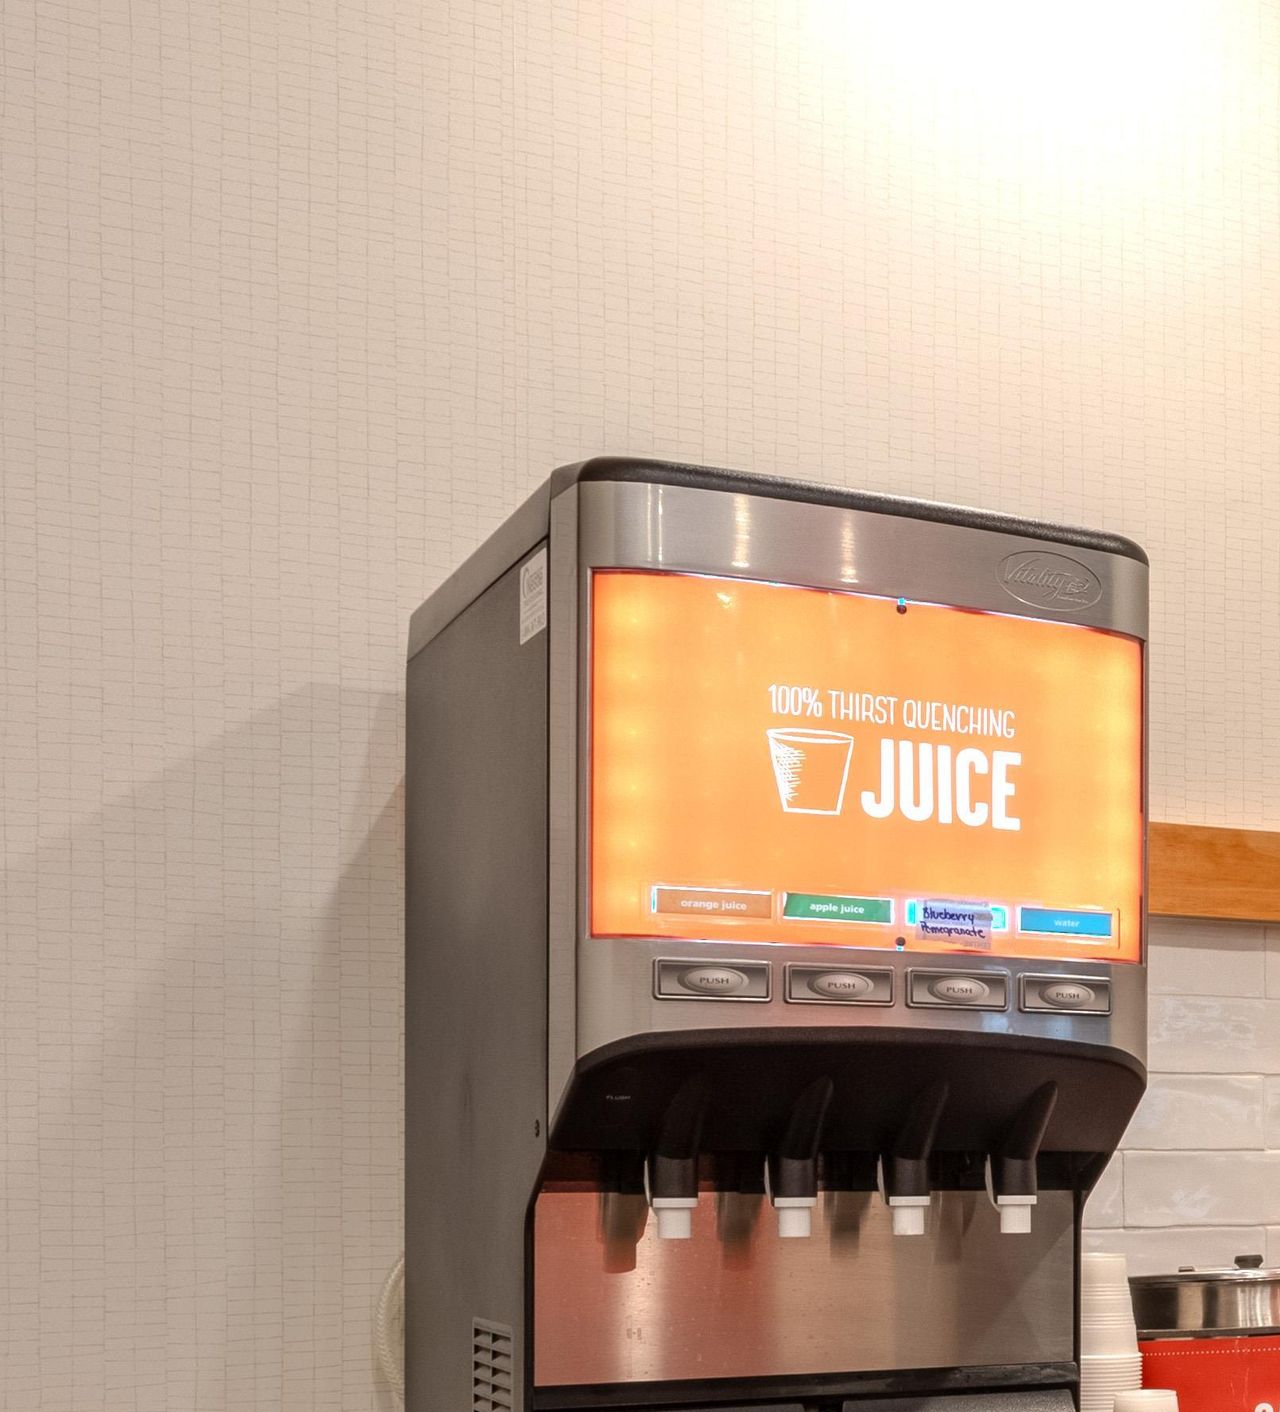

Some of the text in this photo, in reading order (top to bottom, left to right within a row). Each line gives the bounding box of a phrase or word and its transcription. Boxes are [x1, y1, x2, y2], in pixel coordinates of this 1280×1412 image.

[767, 683, 1016, 739] 100% THIRST QUENCHING
[860, 738, 1022, 831] JUICE
[680, 899, 748, 911] orange juice
[809, 902, 865, 915] apple juice
[922, 907, 976, 925] Blueberry
[1053, 919, 1081, 928] water
[699, 976, 730, 985] PUSH
[827, 981, 856, 990] PUSH
[946, 986, 973, 995] PUSH
[1055, 991, 1080, 1000] PUSH
